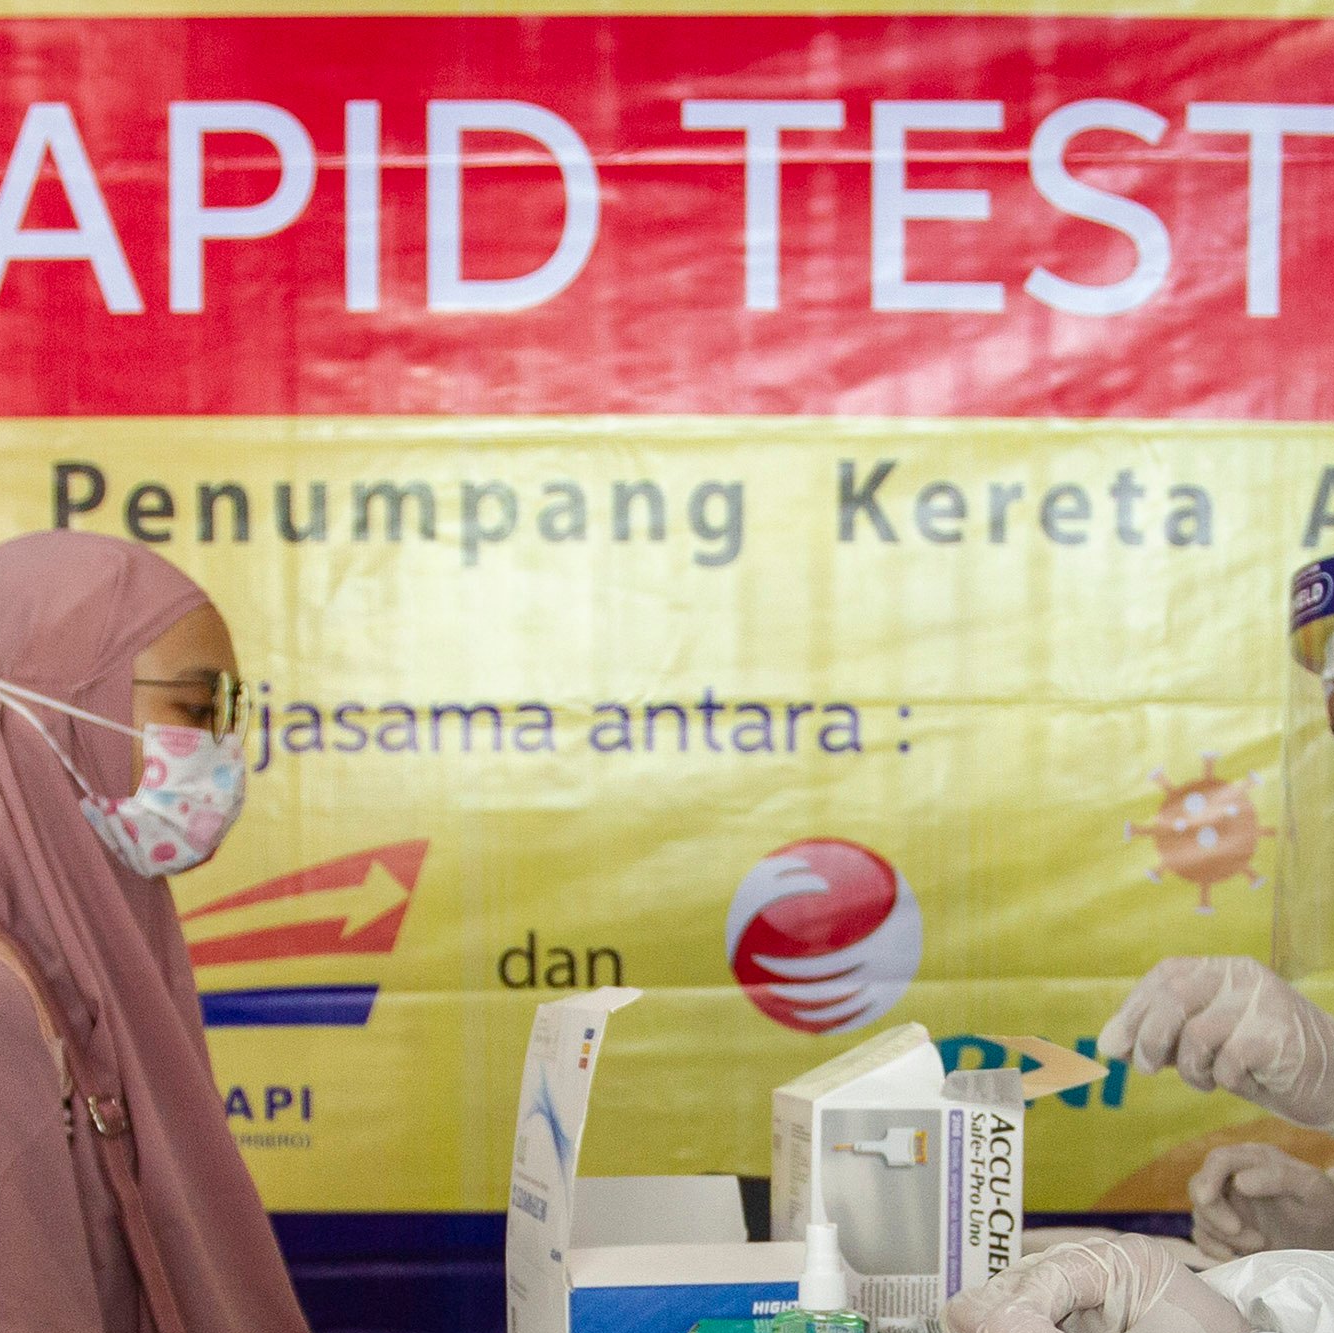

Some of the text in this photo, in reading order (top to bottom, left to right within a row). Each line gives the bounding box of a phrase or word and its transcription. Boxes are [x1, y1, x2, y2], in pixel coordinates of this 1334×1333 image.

[53, 461, 746, 567] Penumpang
[835, 460, 1214, 547] Kereta
[253, 680, 555, 772] jasama
[588, 686, 864, 755] antara
[497, 930, 624, 990] dan
[224, 1085, 312, 1121] API
[968, 1110, 987, 1247] Safe-T-Pro Uno
[752, 1300, 799, 1315] HIGH
